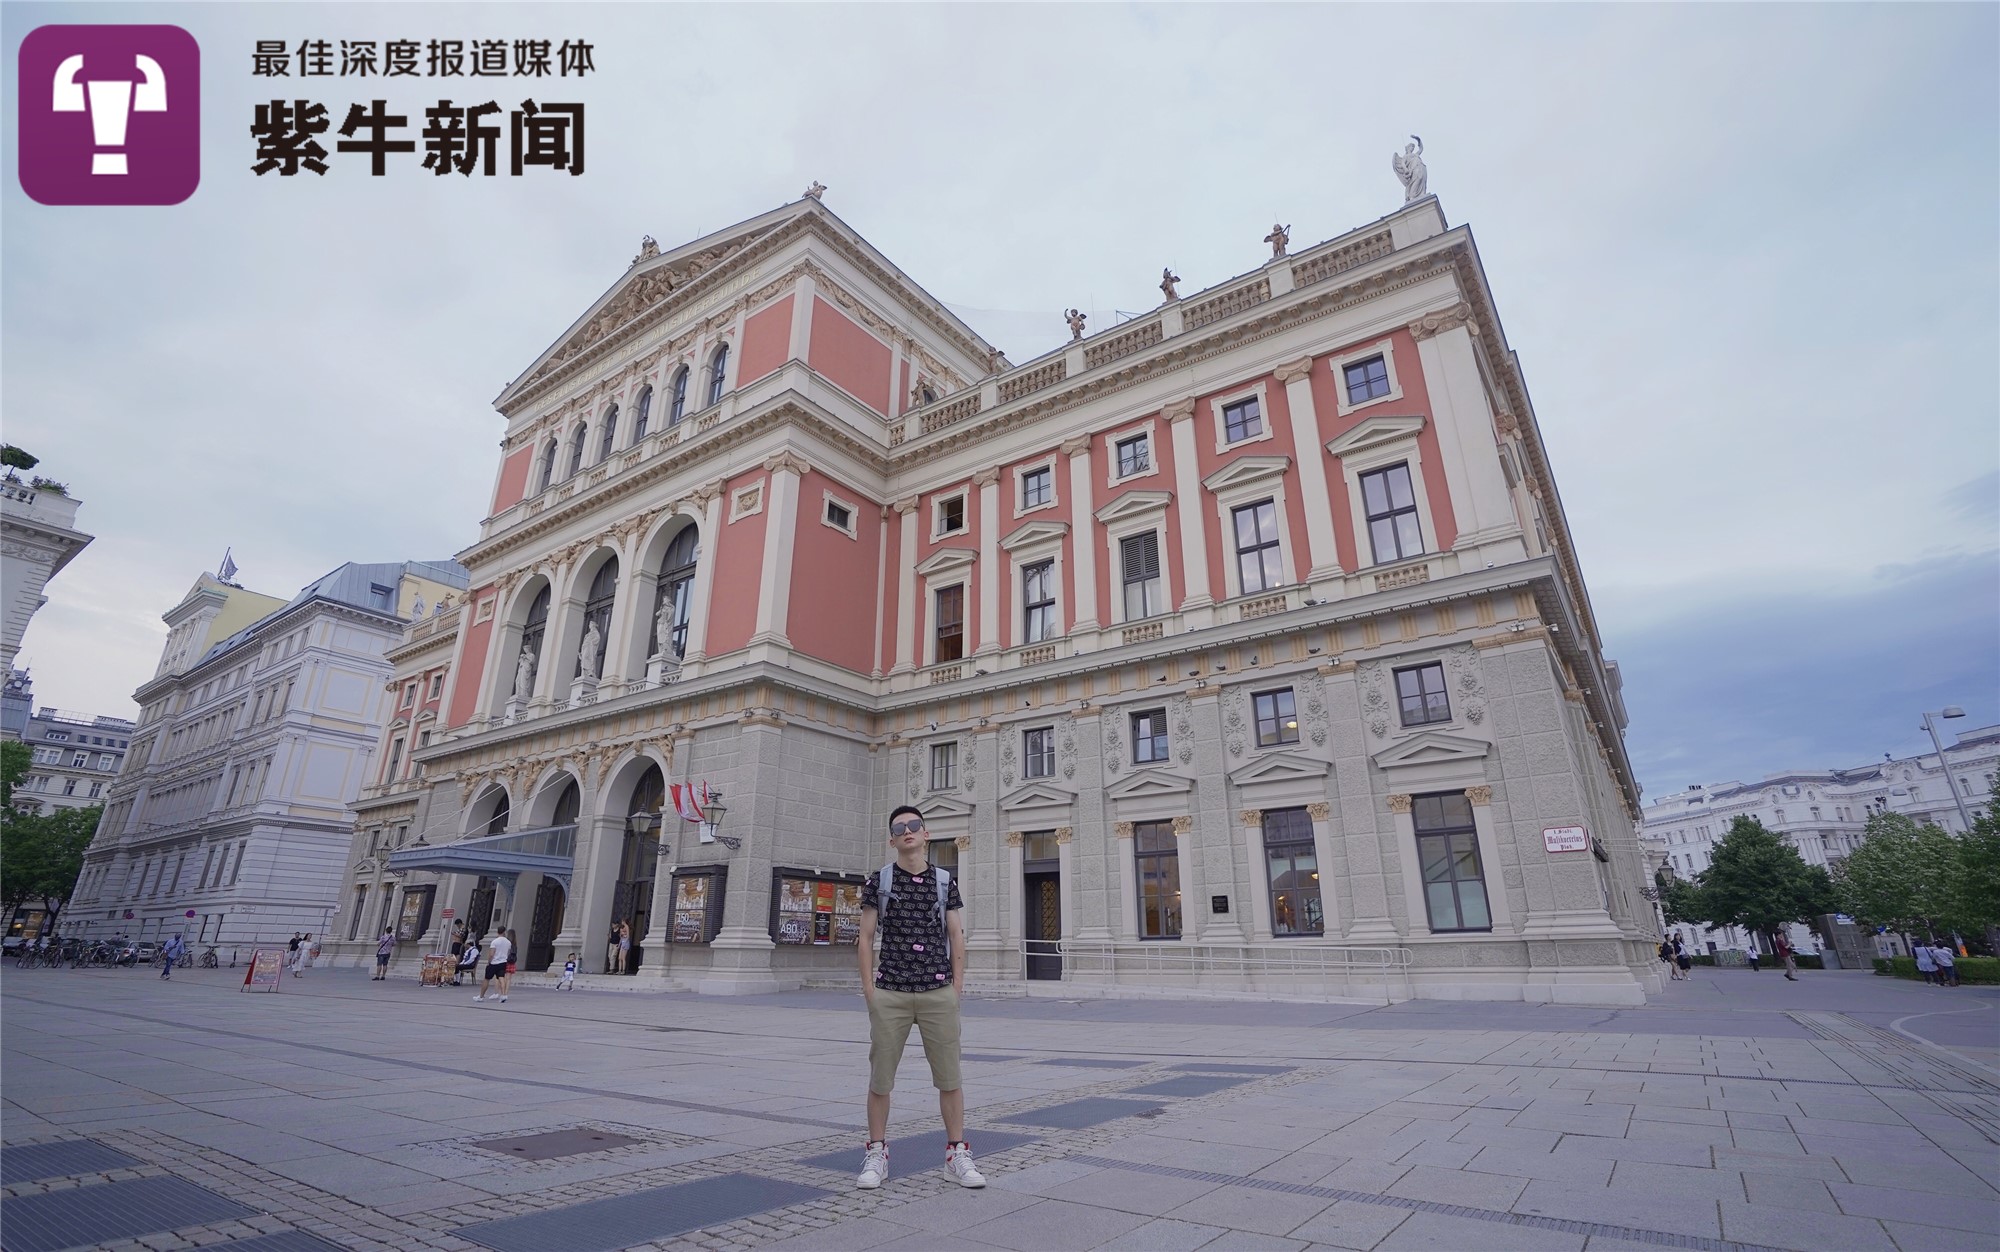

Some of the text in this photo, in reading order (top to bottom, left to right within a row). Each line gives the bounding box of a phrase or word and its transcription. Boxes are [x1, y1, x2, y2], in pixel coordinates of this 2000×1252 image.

[534, 267, 761, 411] GESELLSCHAFT DER MUSIKFREUNDE
[780, 924, 798, 934] ABO
